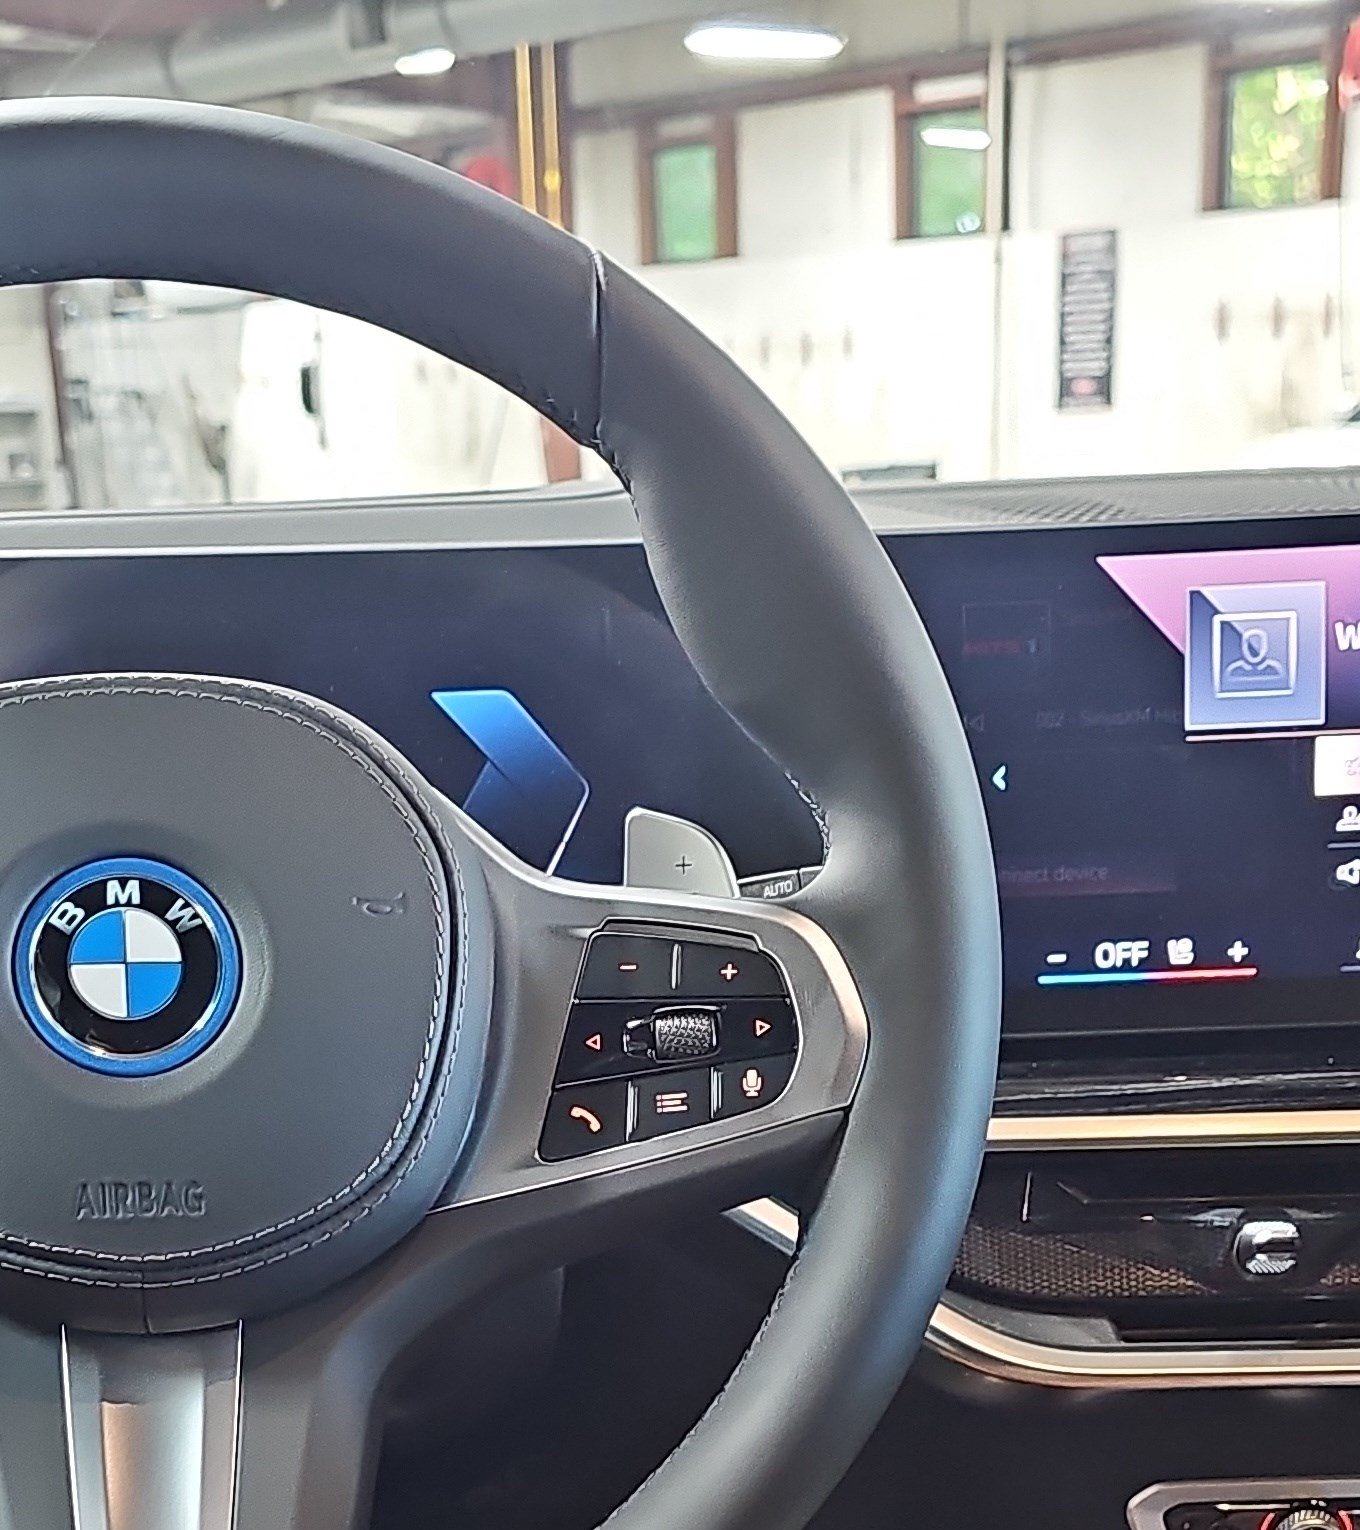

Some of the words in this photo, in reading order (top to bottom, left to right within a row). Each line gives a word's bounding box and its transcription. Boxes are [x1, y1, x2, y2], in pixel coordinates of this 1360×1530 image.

[48, 879, 203, 935] BMW
[1095, 940, 1150, 968] OFF
[75, 1180, 207, 1221] AIRBAG
